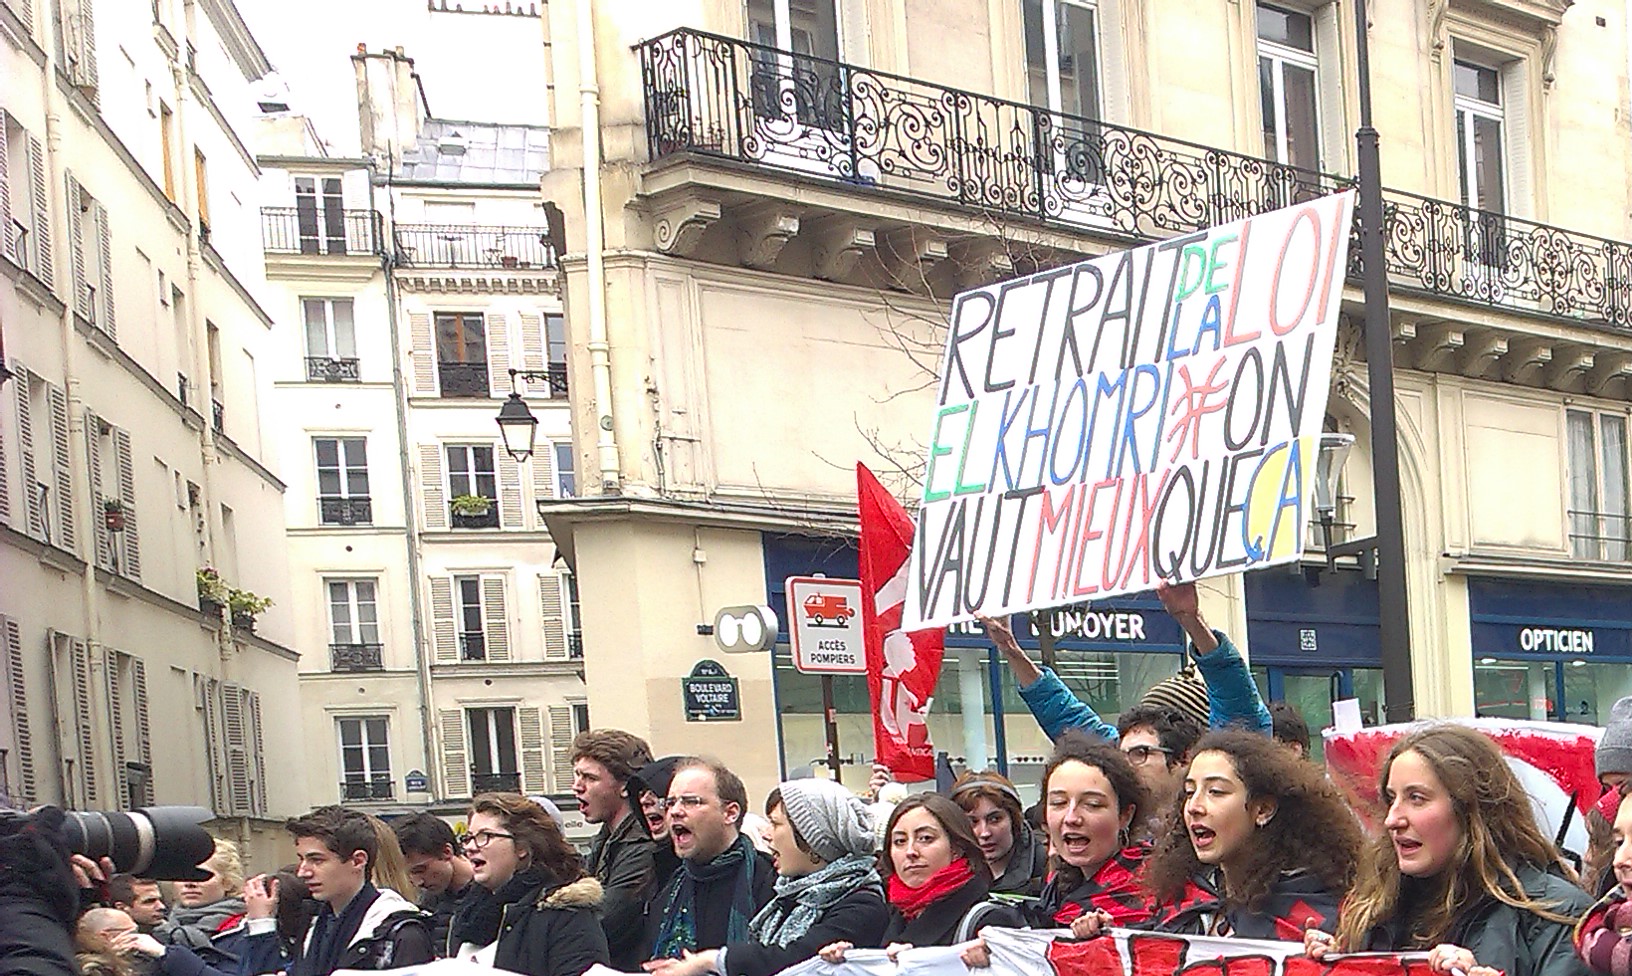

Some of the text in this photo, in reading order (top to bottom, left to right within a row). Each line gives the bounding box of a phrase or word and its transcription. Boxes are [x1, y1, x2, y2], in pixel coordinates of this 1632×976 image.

[940, 198, 1346, 405] RETRAIT DE LOI
[1166, 294, 1221, 362] LA
[924, 400, 987, 501] EL
[988, 359, 1174, 493] KHOMRI
[920, 438, 1303, 622] VAUT MIEUX QUE ÇA
[810, 652, 856, 665] POMPIERS
[818, 639, 846, 651] ACCÈS
[1520, 628, 1594, 652] OPTICIEN
[694, 693, 729, 703] VOLTAIRE
